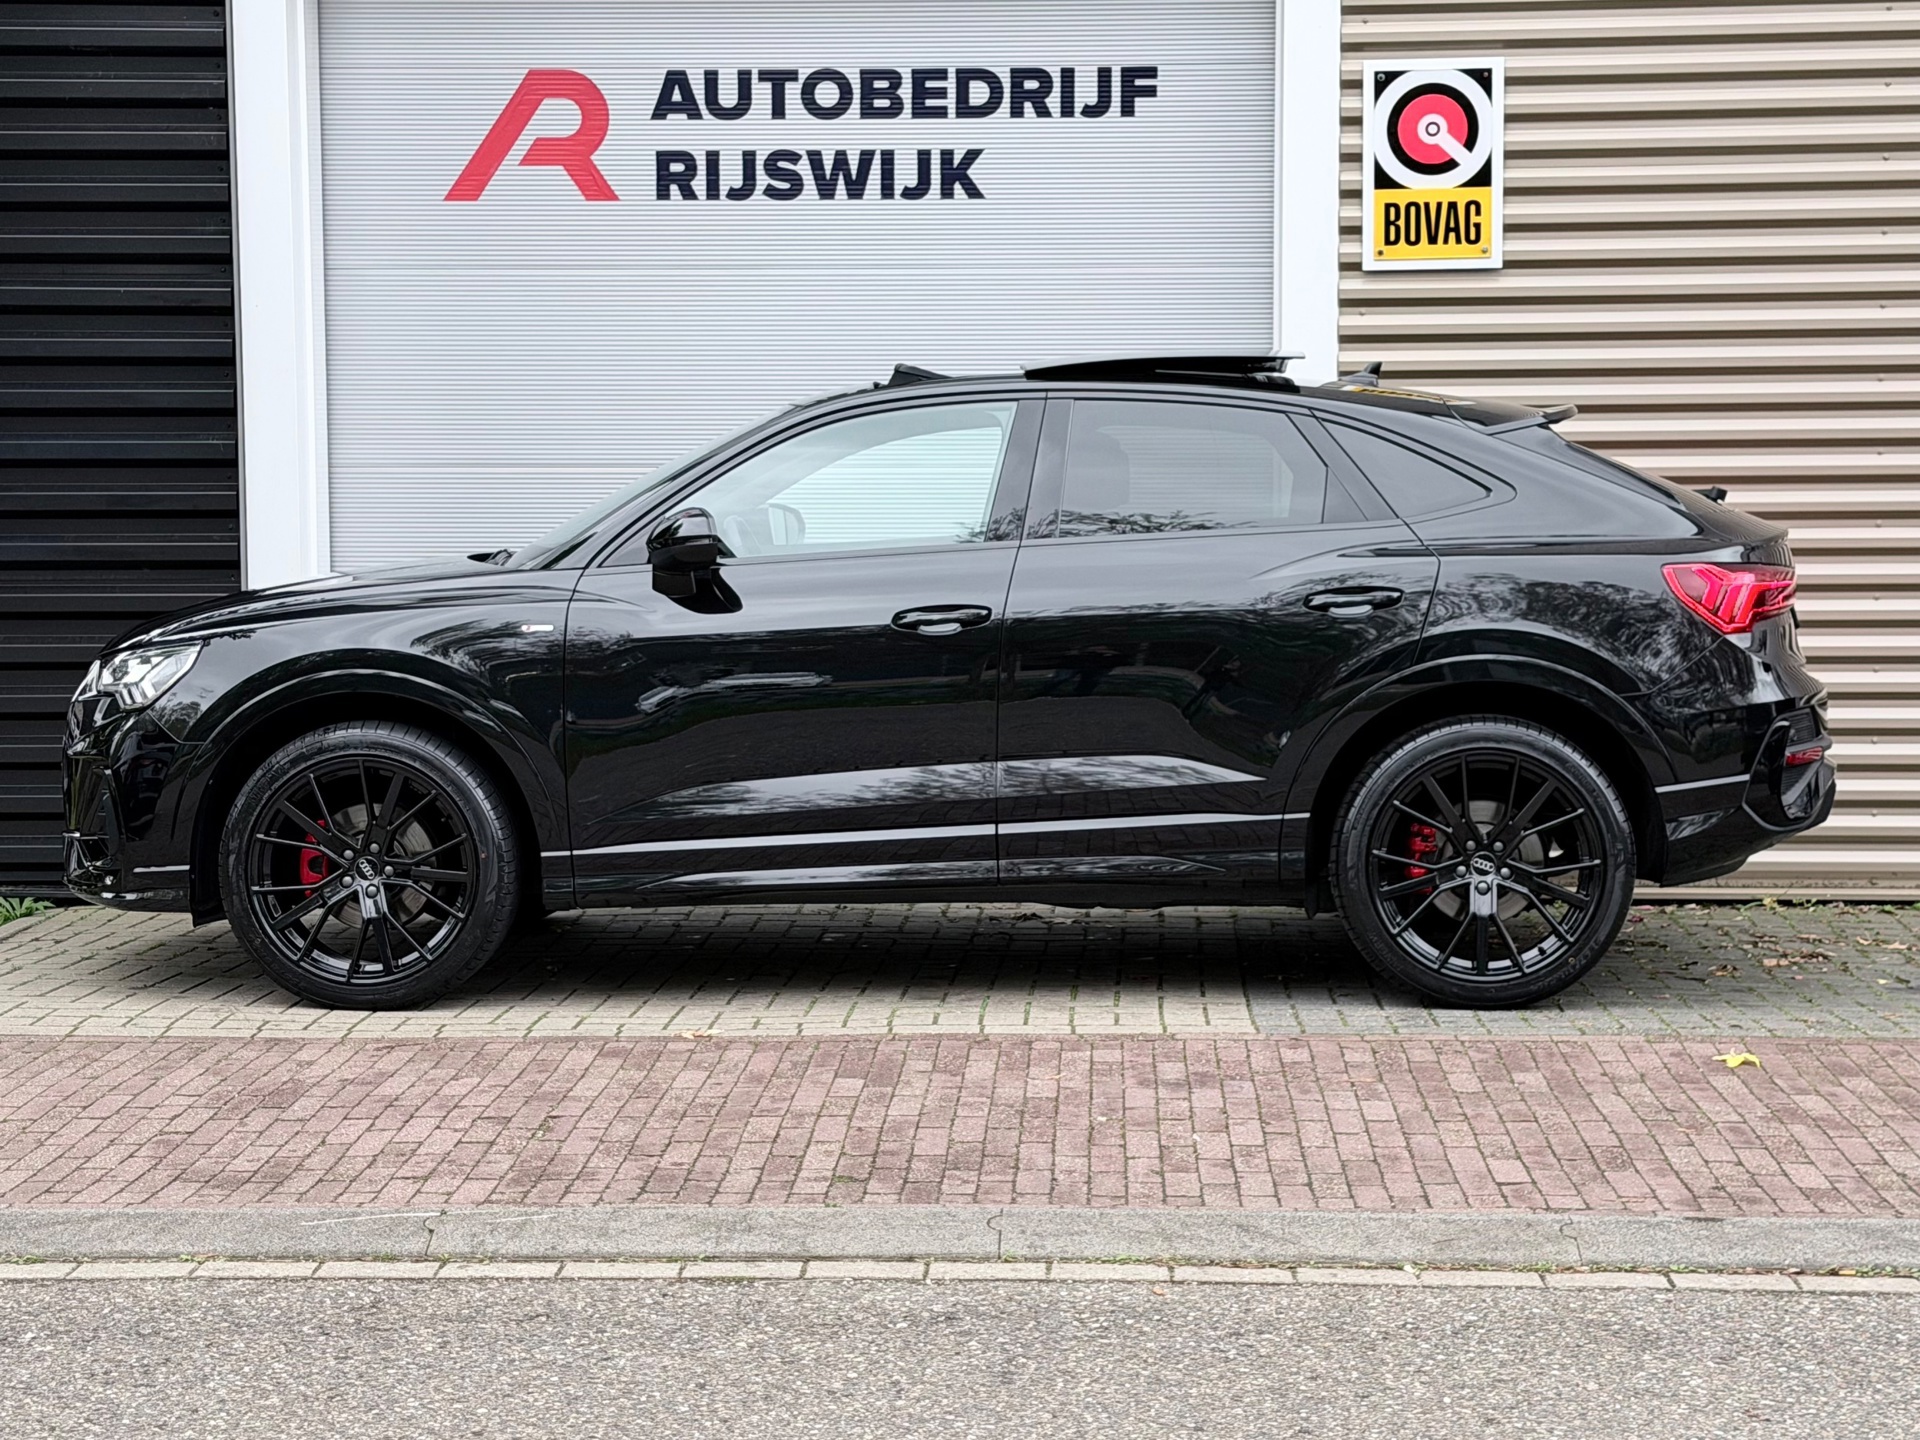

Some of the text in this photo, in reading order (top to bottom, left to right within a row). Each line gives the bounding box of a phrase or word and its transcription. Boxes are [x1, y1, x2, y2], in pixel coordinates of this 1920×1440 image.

[651, 66, 1158, 120] AUTOBEDRIJF
[655, 149, 985, 200] RIJSWIJK
[1384, 200, 1482, 246] BOVAG
